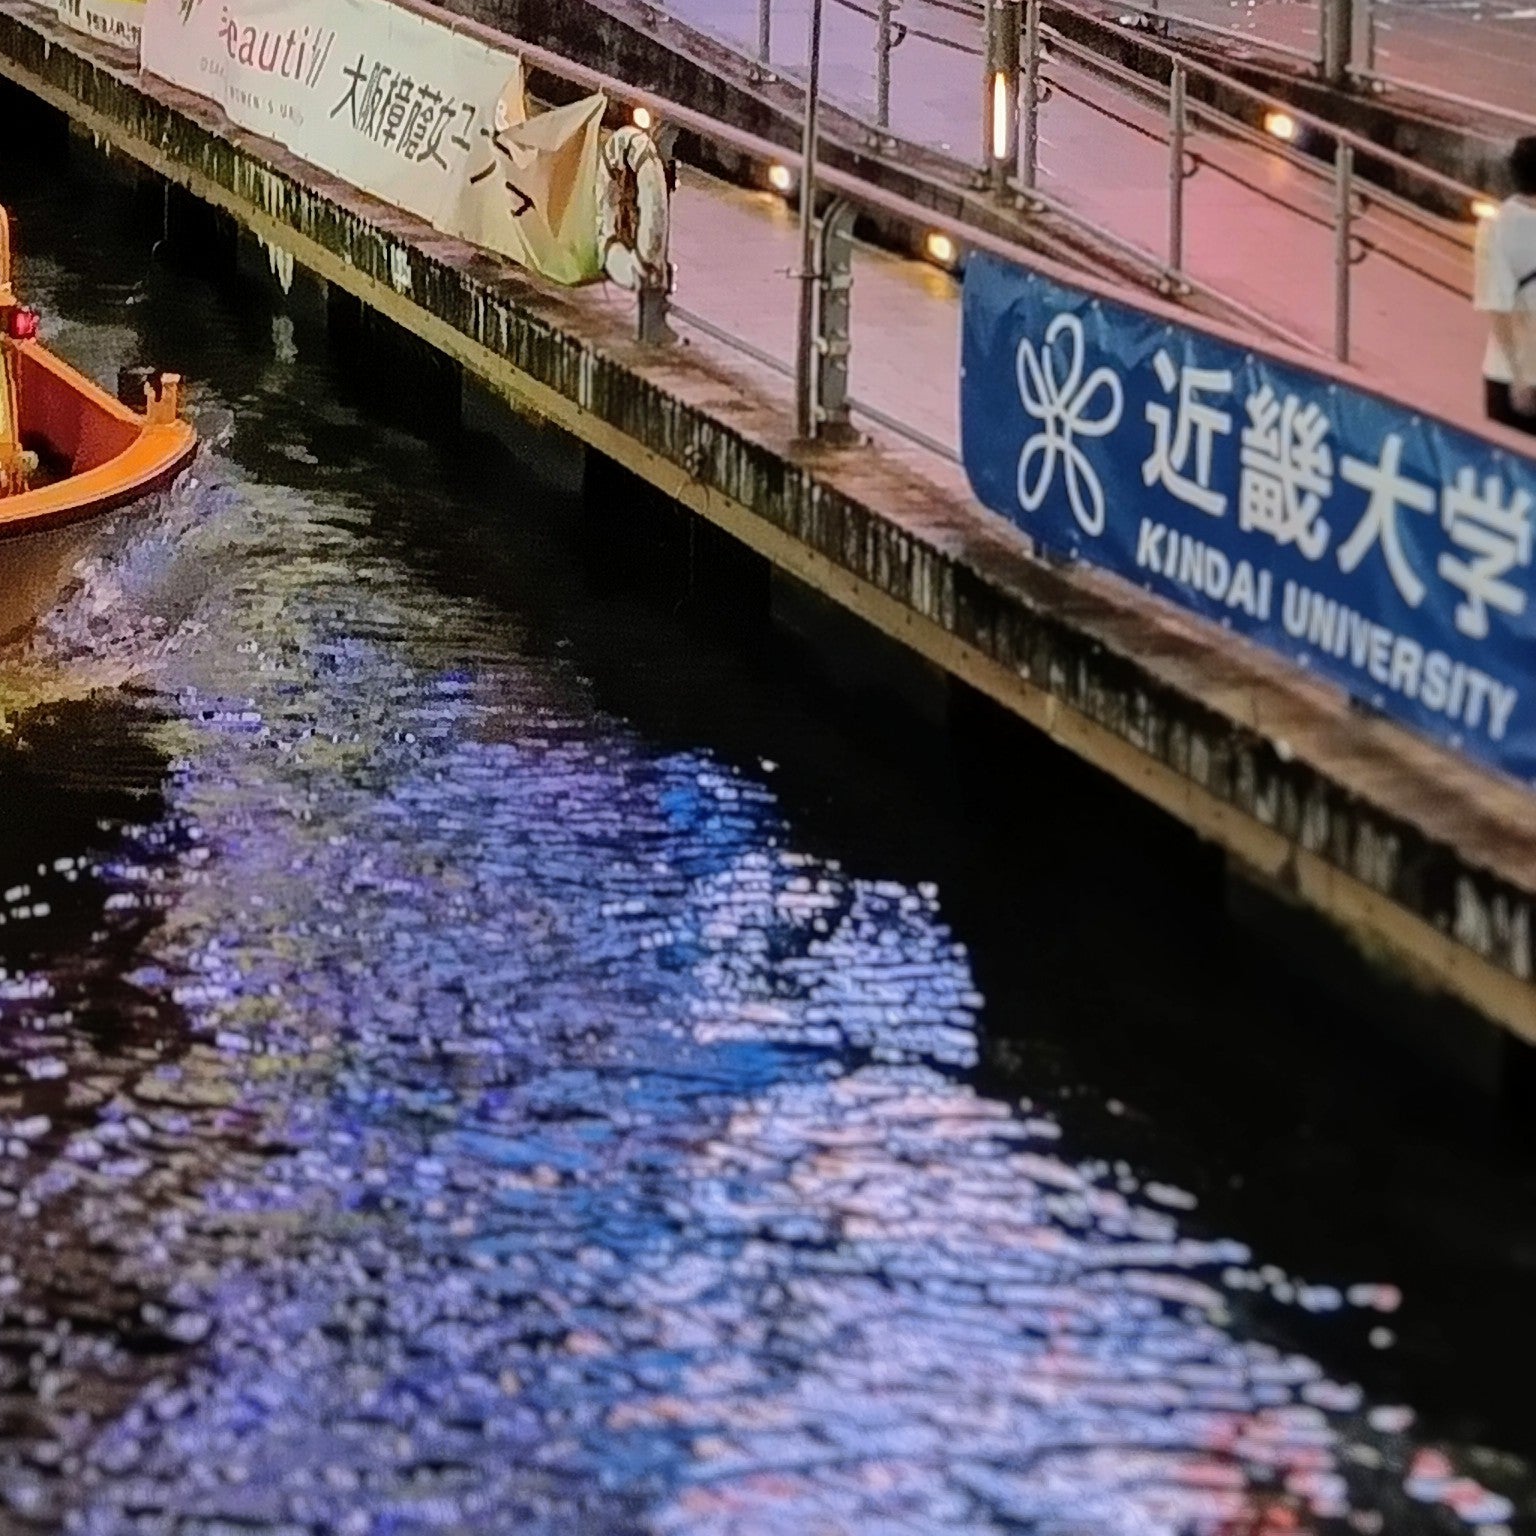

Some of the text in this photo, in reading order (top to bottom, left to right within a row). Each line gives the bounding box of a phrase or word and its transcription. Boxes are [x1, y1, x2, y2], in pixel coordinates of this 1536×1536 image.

[1141, 348, 1534, 639] 近畿大学
[1136, 518, 1519, 741] KINDAI UNIVERSITY
